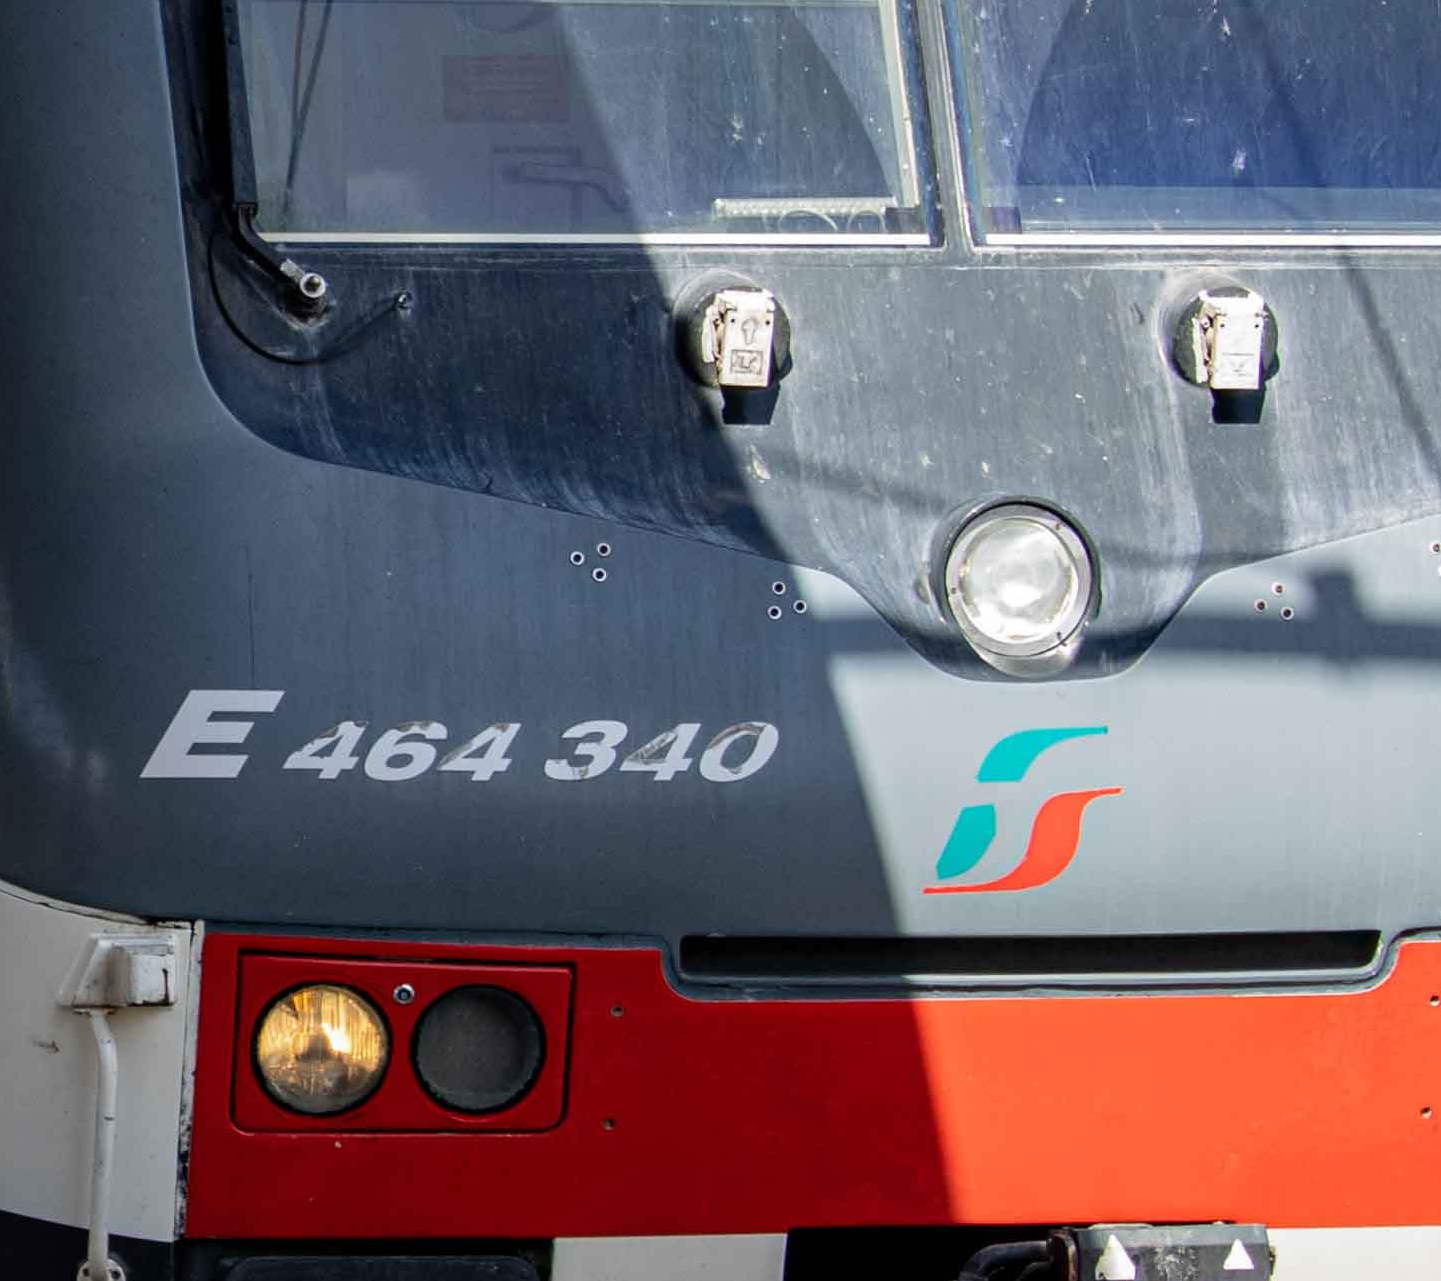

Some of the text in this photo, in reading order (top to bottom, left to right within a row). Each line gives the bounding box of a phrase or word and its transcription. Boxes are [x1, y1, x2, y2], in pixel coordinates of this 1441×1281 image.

[139, 689, 779, 783] E 464 340
